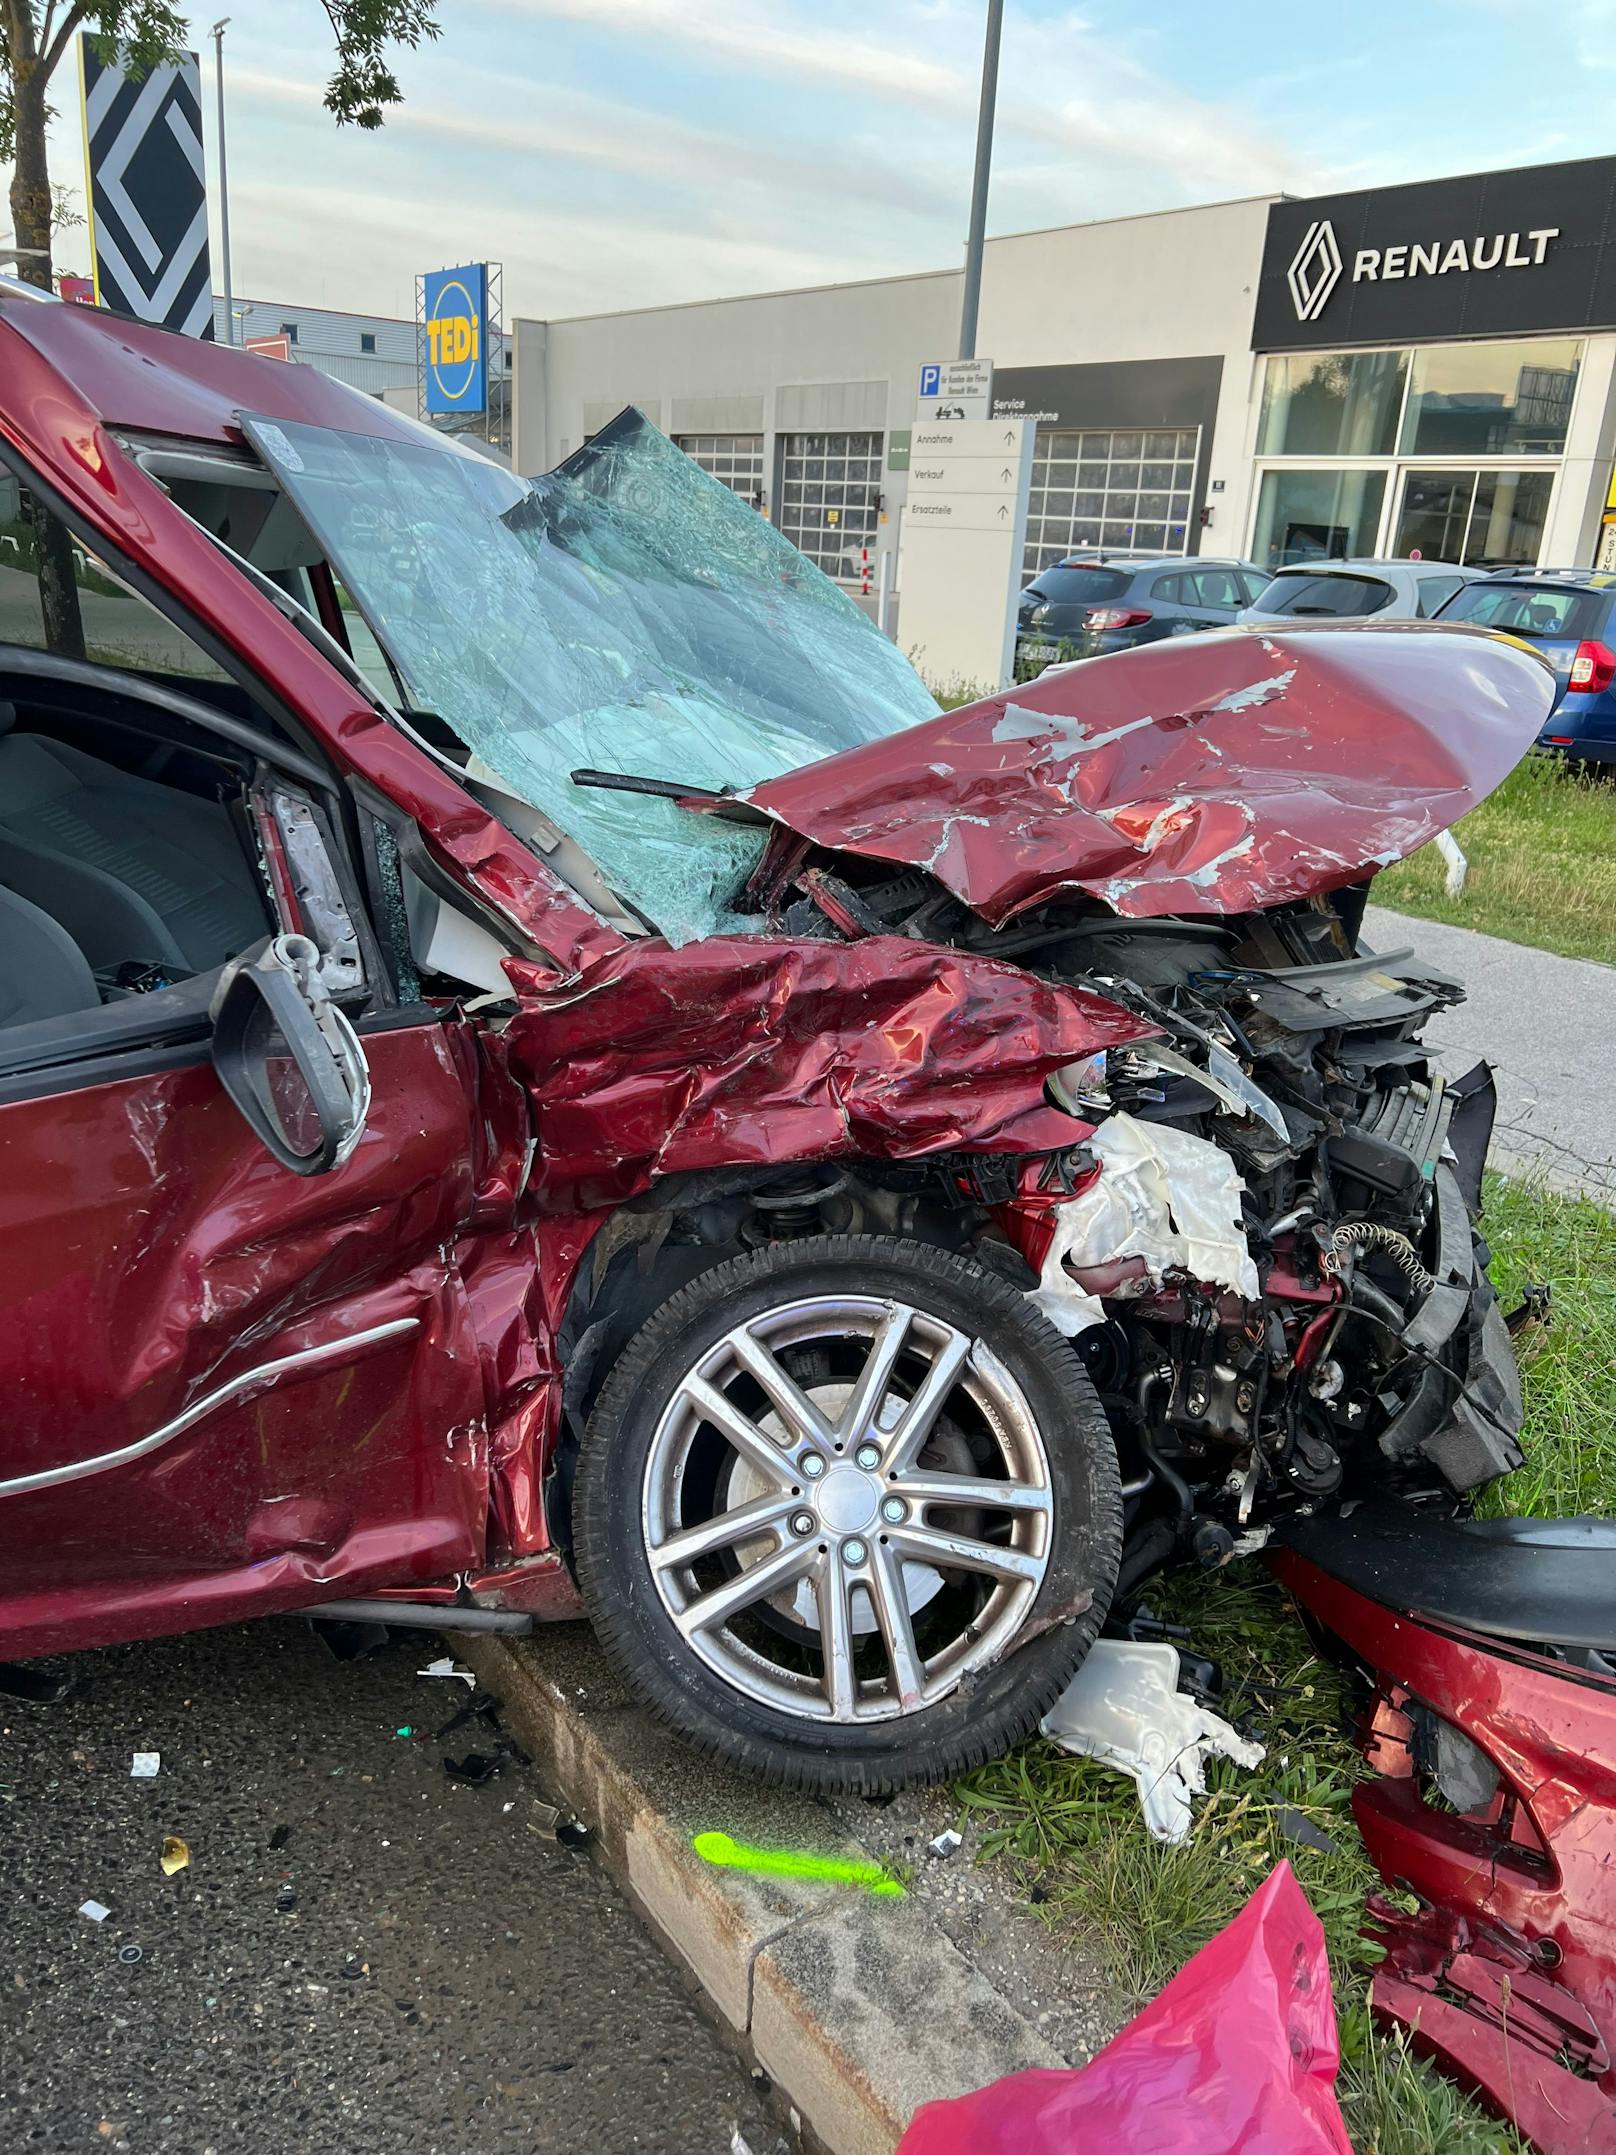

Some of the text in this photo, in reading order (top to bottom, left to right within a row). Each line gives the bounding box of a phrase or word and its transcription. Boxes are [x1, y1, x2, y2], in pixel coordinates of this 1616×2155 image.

[1353, 228, 1559, 282] RENAULT
[427, 314, 478, 366] TEDi
[993, 398, 1025, 410] Service
[916, 435, 953, 444] Annahme
[914, 470, 944, 479] Verkauf
[911, 504, 952, 515] Ersatzteile
